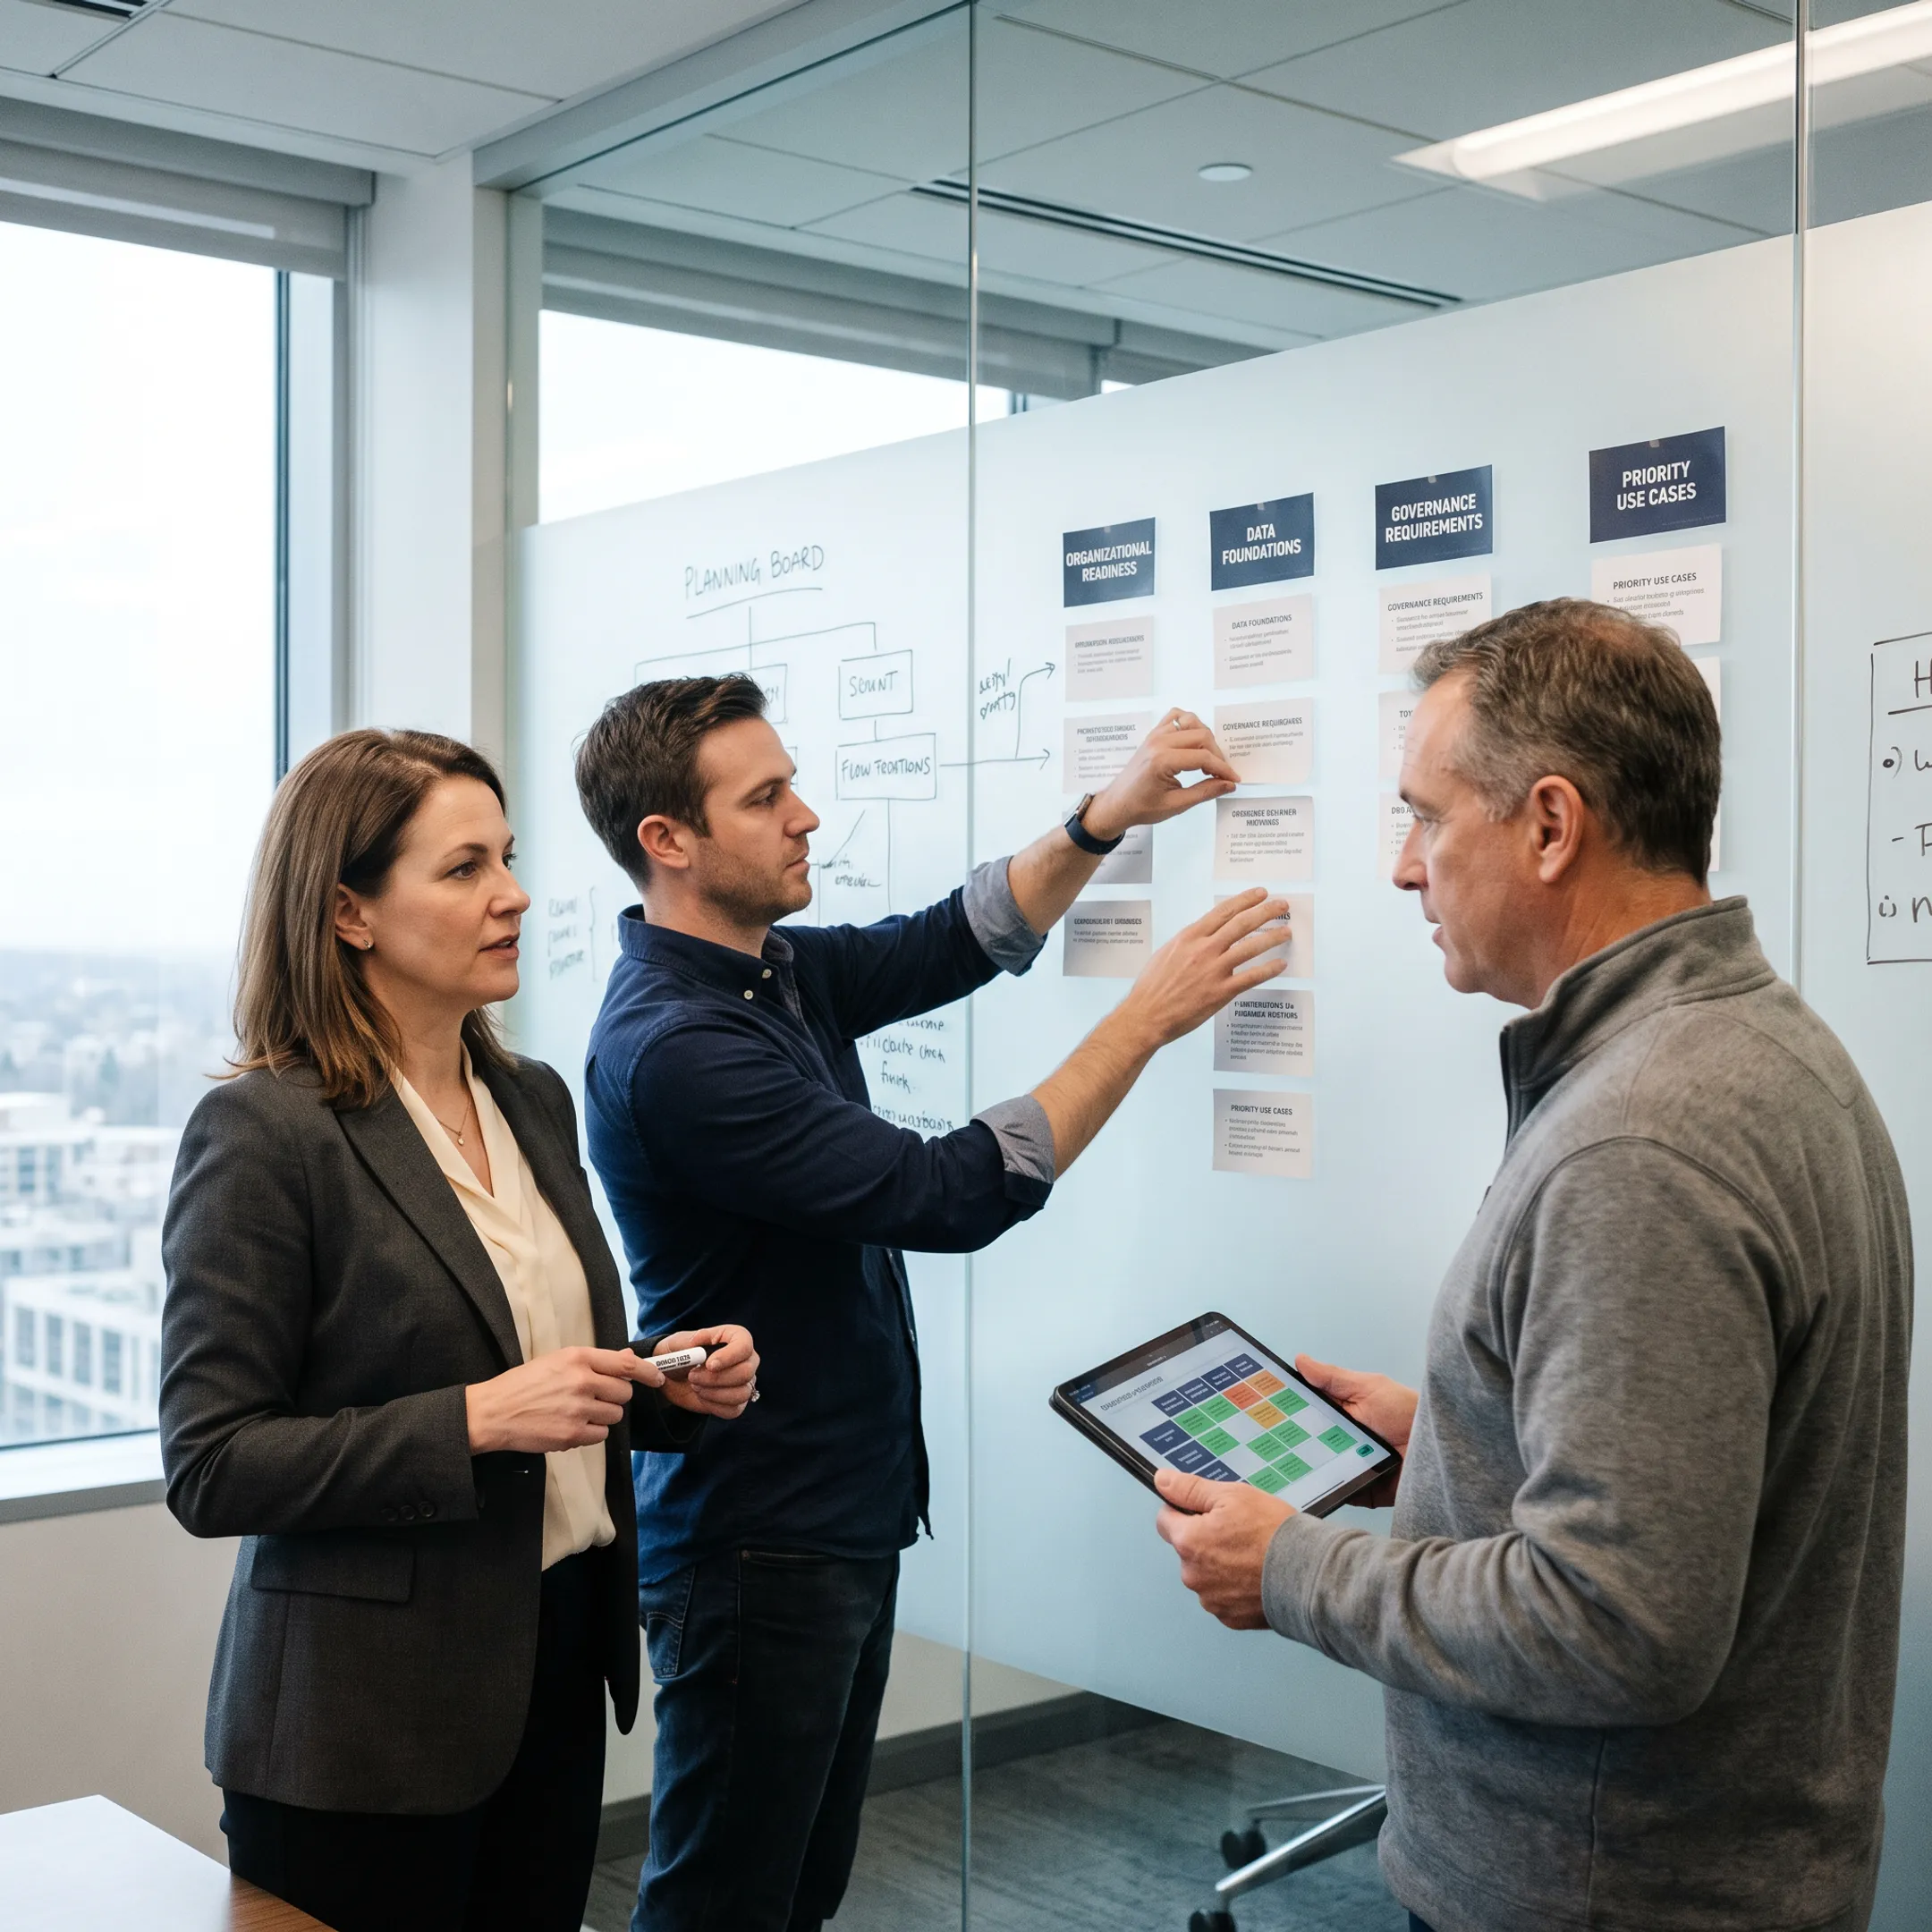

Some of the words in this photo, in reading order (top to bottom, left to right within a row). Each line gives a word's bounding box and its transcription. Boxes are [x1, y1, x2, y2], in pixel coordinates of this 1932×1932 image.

[1623, 461, 1690, 487] PRIORITY
[1391, 493, 1477, 521] GOVERNANCE
[1616, 490, 1645, 511] USE
[1648, 482, 1697, 505] CASES
[1247, 523, 1275, 542] DATA
[1385, 513, 1483, 543] REQUIREMENTS
[1066, 541, 1152, 567] ORGANIZATIONAL
[1222, 538, 1301, 565] FOUNDATIONS
[685, 557, 761, 600] PLANNING
[771, 545, 824, 579] BOARD
[1082, 561, 1137, 582] READINESS
[1613, 578, 1652, 589] PRIORITY
[1653, 576, 1669, 586] USE
[1671, 572, 1697, 583] CASES
[1387, 598, 1432, 611] GOVERNANCE
[1433, 592, 1483, 606] REQUIREMENTS
[1232, 621, 1248, 630] DATA
[1249, 614, 1292, 627] FOUNDATIONS
[1223, 721, 1260, 731] GOVERNANCE
[1231, 1105, 1258, 1113] PRIORITY
[1259, 1106, 1271, 1114] USE
[1273, 1107, 1292, 1115] CASES
